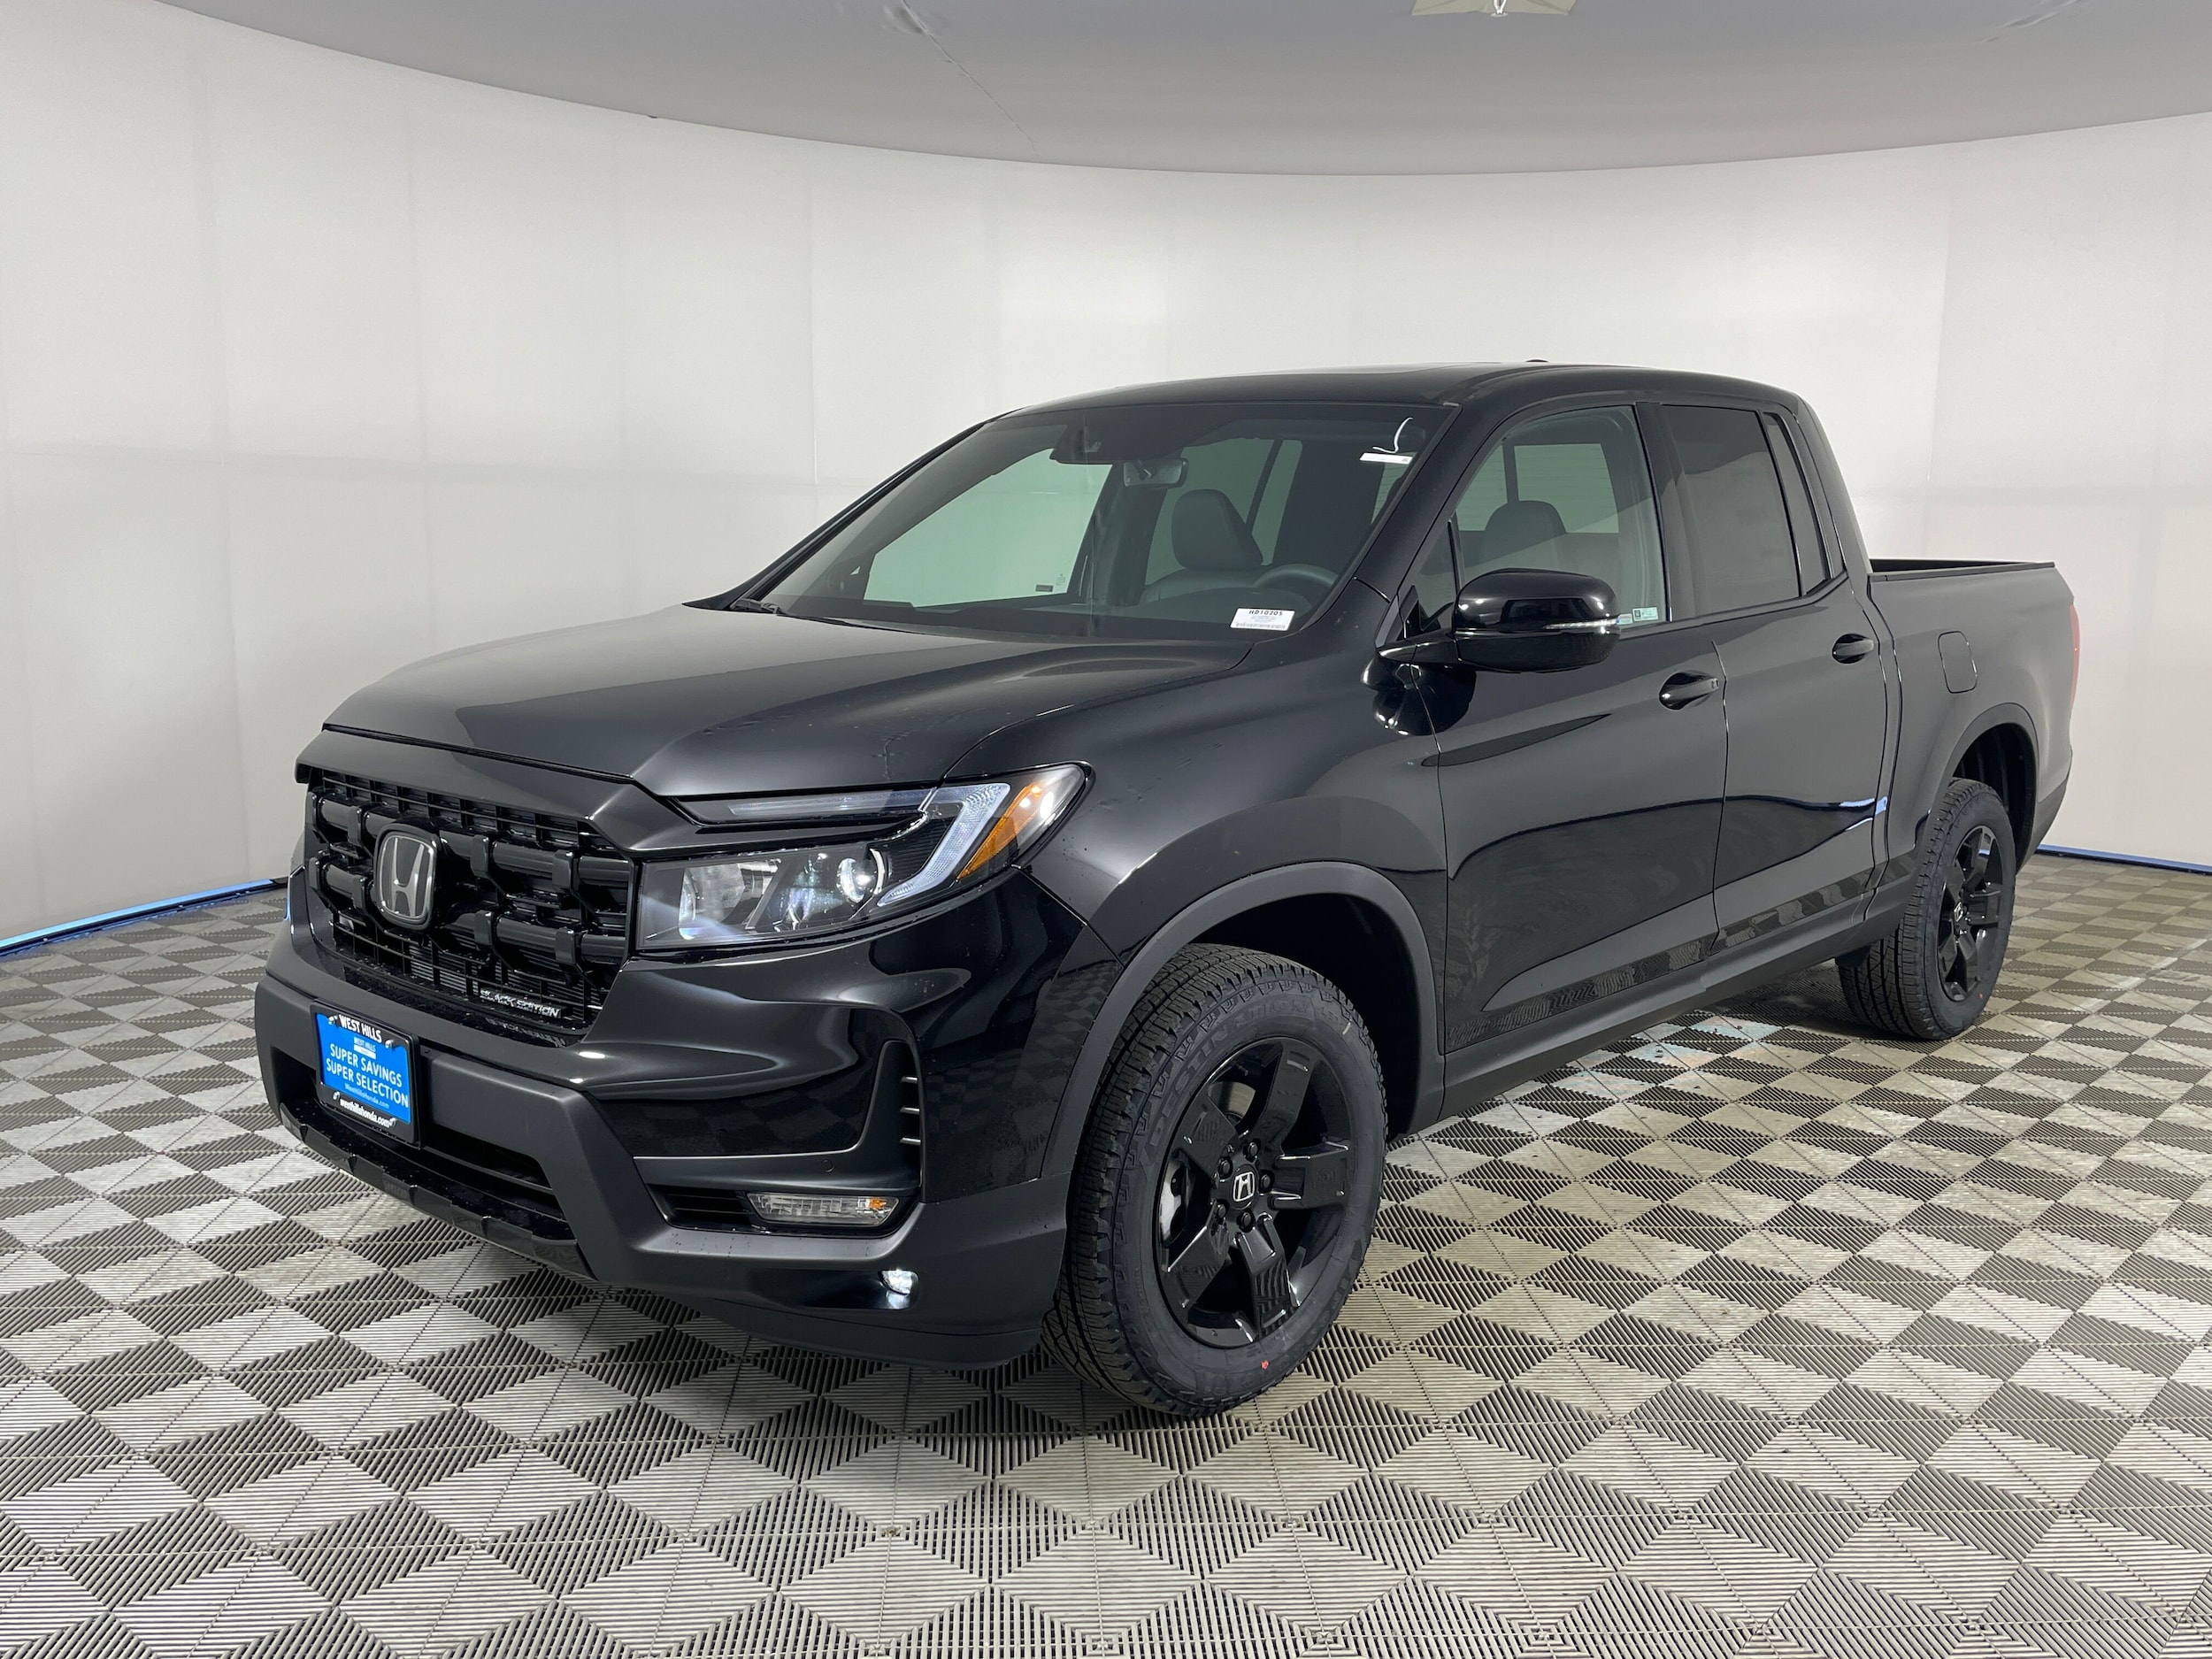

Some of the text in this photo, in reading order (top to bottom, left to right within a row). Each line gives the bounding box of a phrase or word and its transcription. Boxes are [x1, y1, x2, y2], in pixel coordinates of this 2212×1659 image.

[480, 989, 561, 1018] BLACK EDITION
[339, 1014, 382, 1043] WEST HILLS
[330, 1043, 403, 1087] SUPER SAVINGS
[326, 1058, 409, 1108] SUPER SELECTION
[340, 1098, 390, 1128] westhillshonda.com
